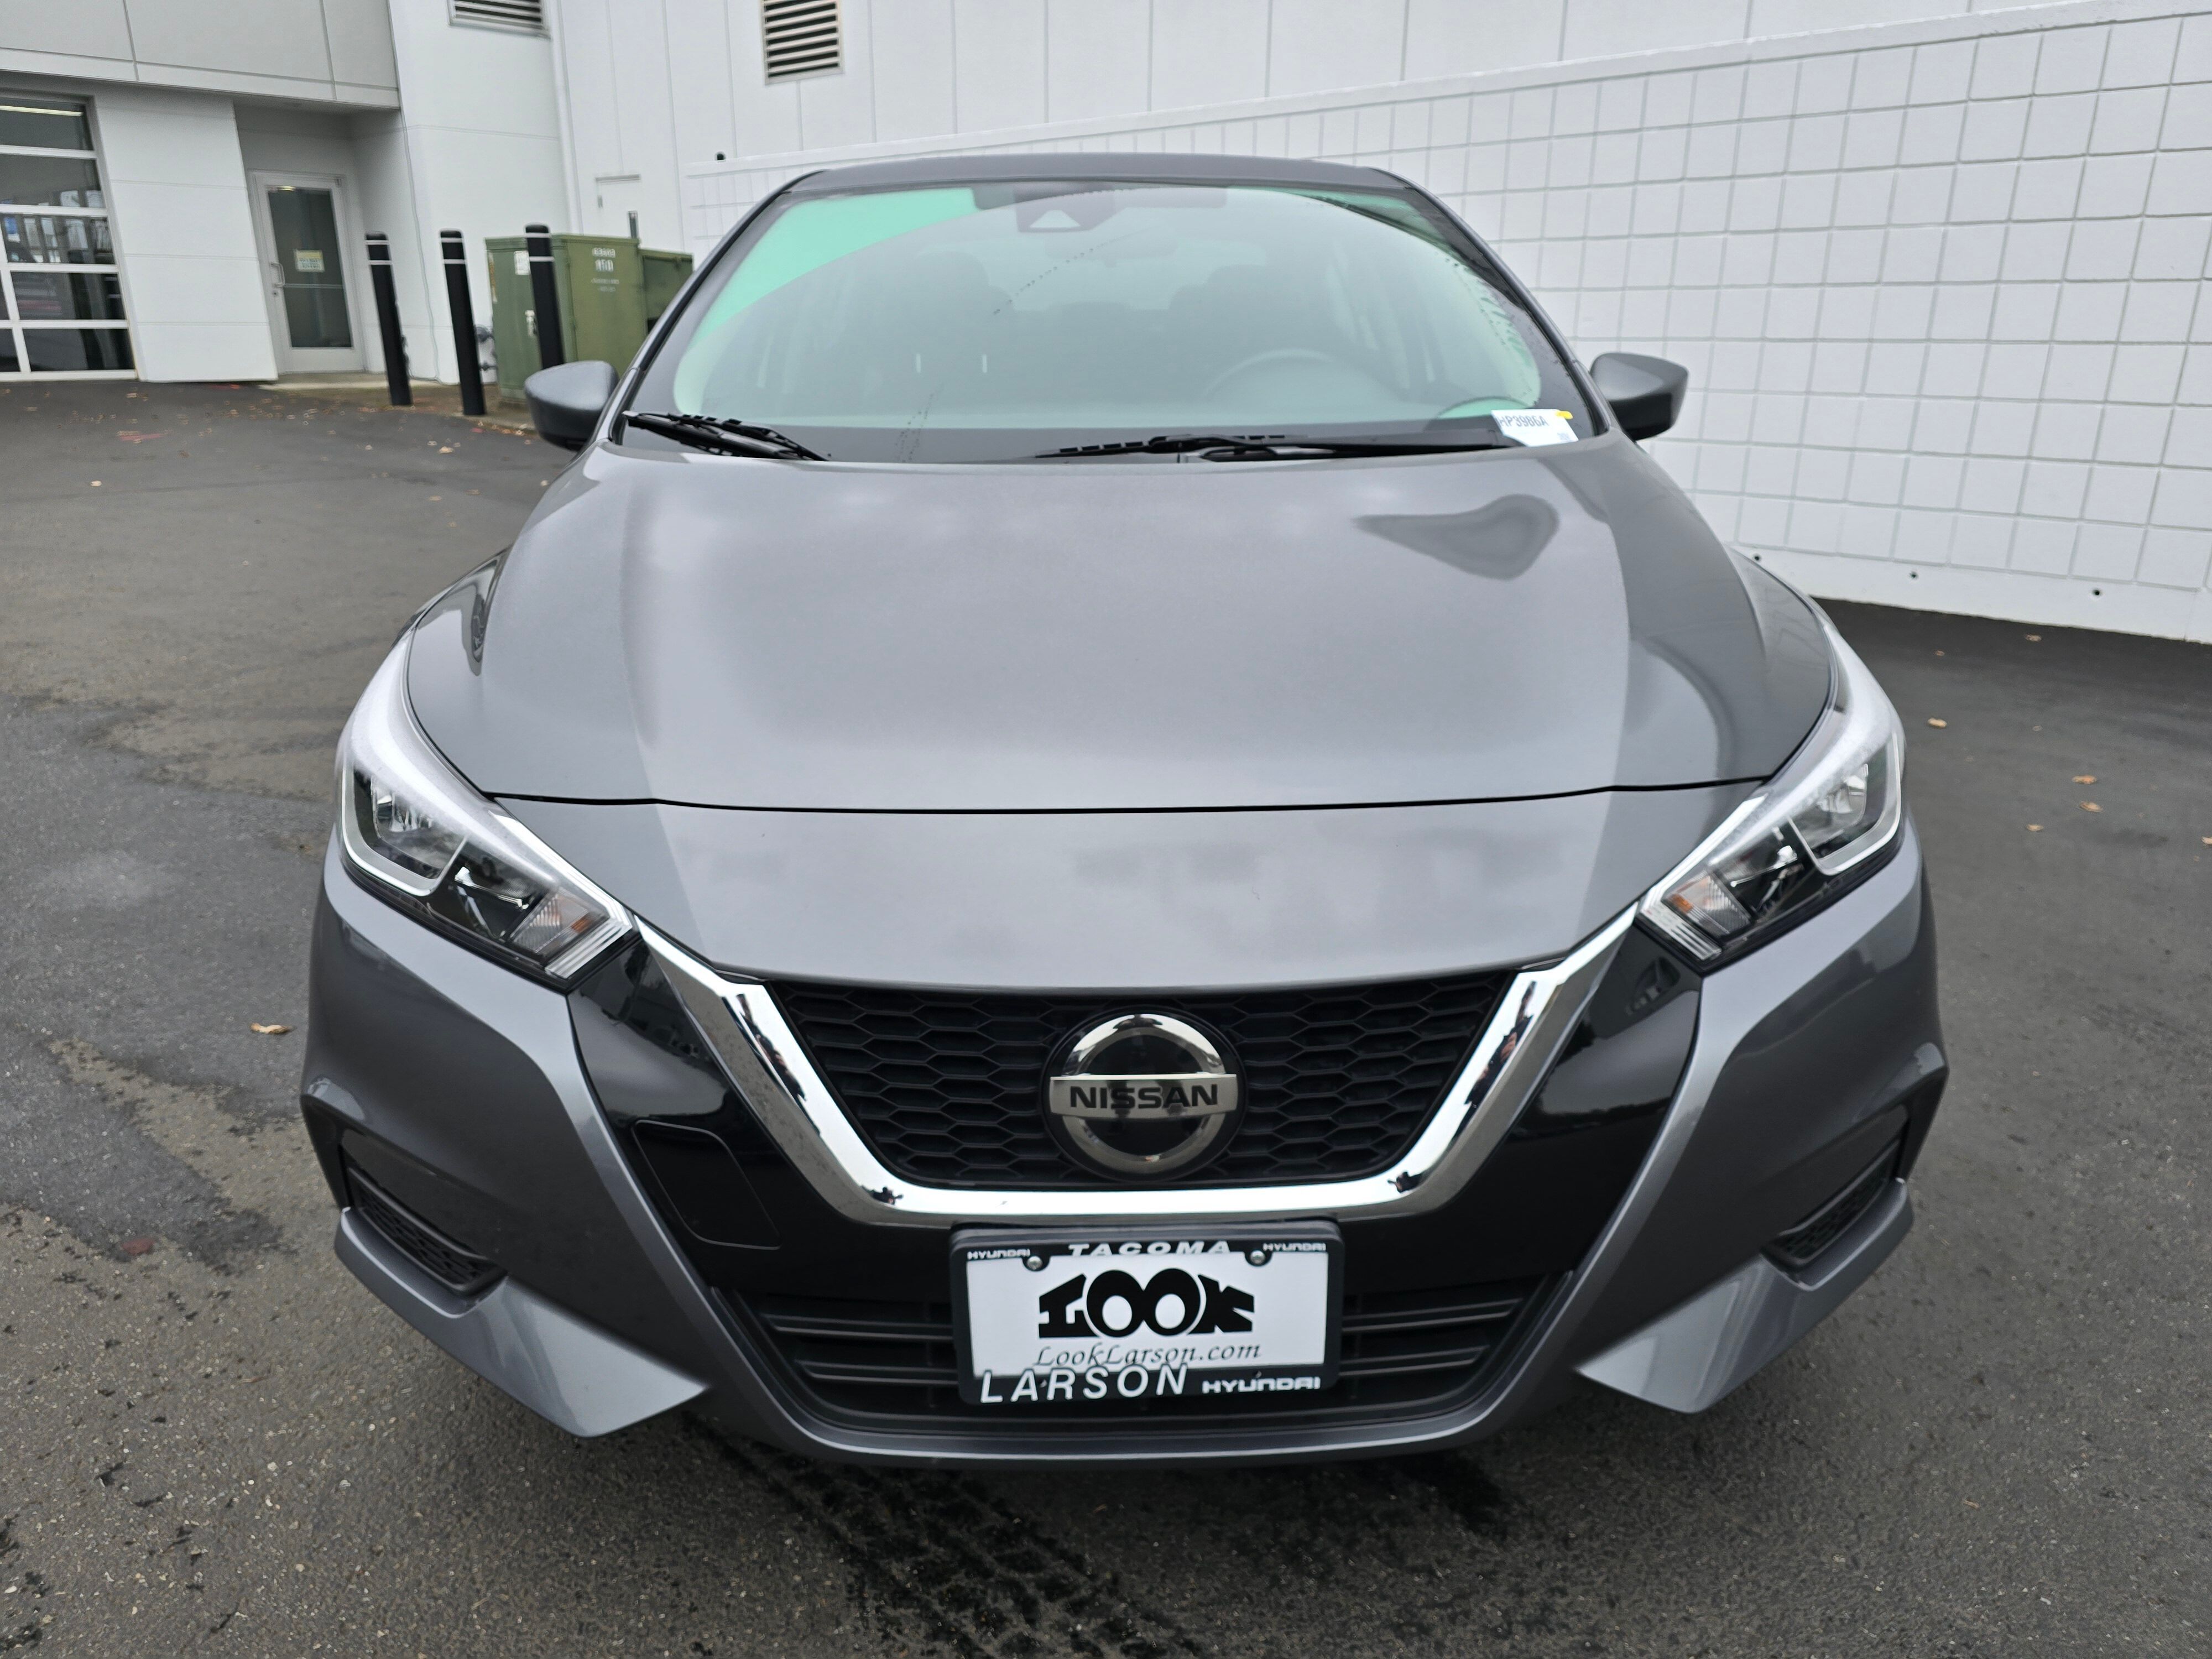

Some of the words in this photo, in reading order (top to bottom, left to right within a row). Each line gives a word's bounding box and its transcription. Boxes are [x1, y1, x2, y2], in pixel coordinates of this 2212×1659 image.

[1499, 415, 1550, 427] HP3986A
[1070, 1084, 1218, 1109] NISSAN
[967, 1249, 1031, 1260] HYUNDAI
[1068, 1241, 1230, 1256] TACOMA
[1262, 1243, 1326, 1251] HYUNDAI
[1039, 1268, 1254, 1338] LOOK
[1032, 1342, 1261, 1366] LookLarson.com
[980, 1363, 1187, 1403] LARSON
[1202, 1376, 1321, 1393] HYUNDAI
